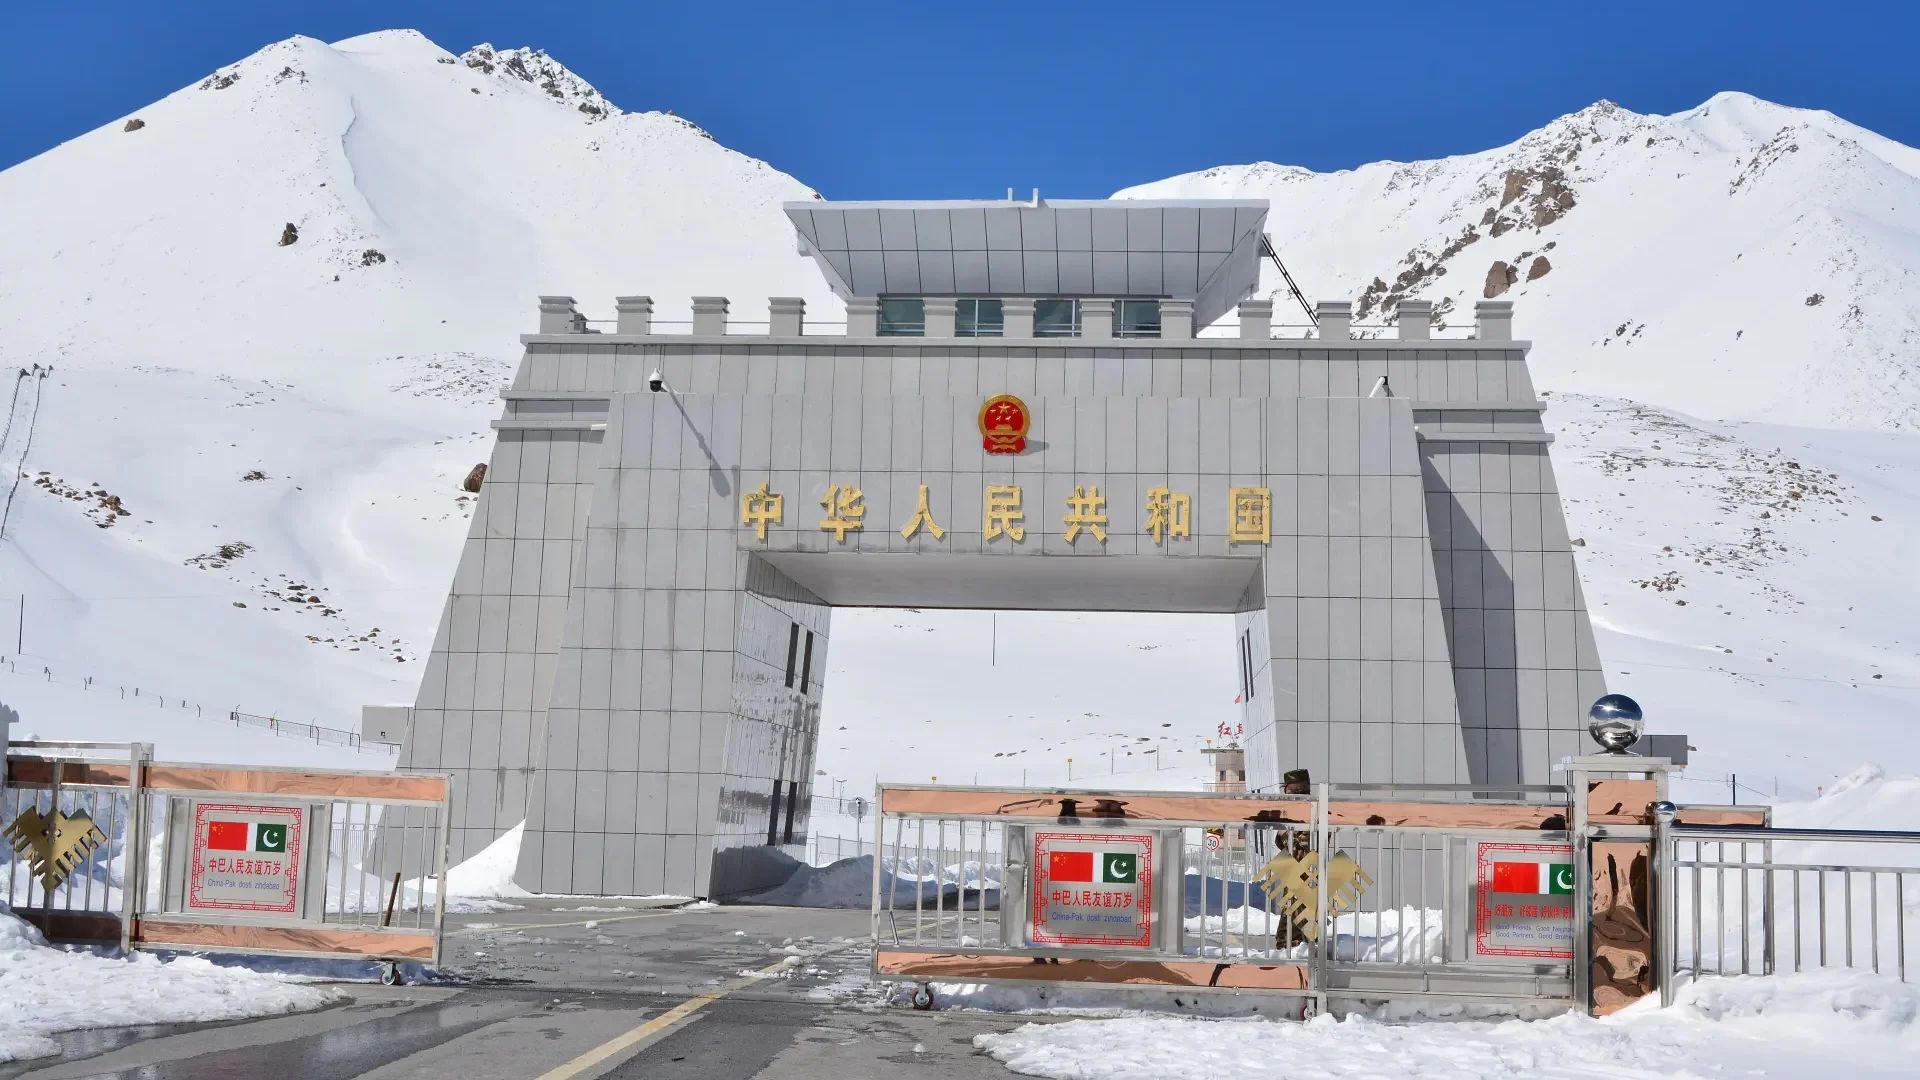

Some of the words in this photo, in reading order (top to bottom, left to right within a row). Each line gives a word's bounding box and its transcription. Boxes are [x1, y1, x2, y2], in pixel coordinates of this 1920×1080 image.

[742, 482, 1272, 545] 中华人民共和国
[209, 857, 281, 876] 中巴人民友谊万岁
[207, 878, 236, 888] China-Pak
[1052, 889, 1133, 908] 中巴人民友谊万岁
[1051, 911, 1083, 921] China-Pak
